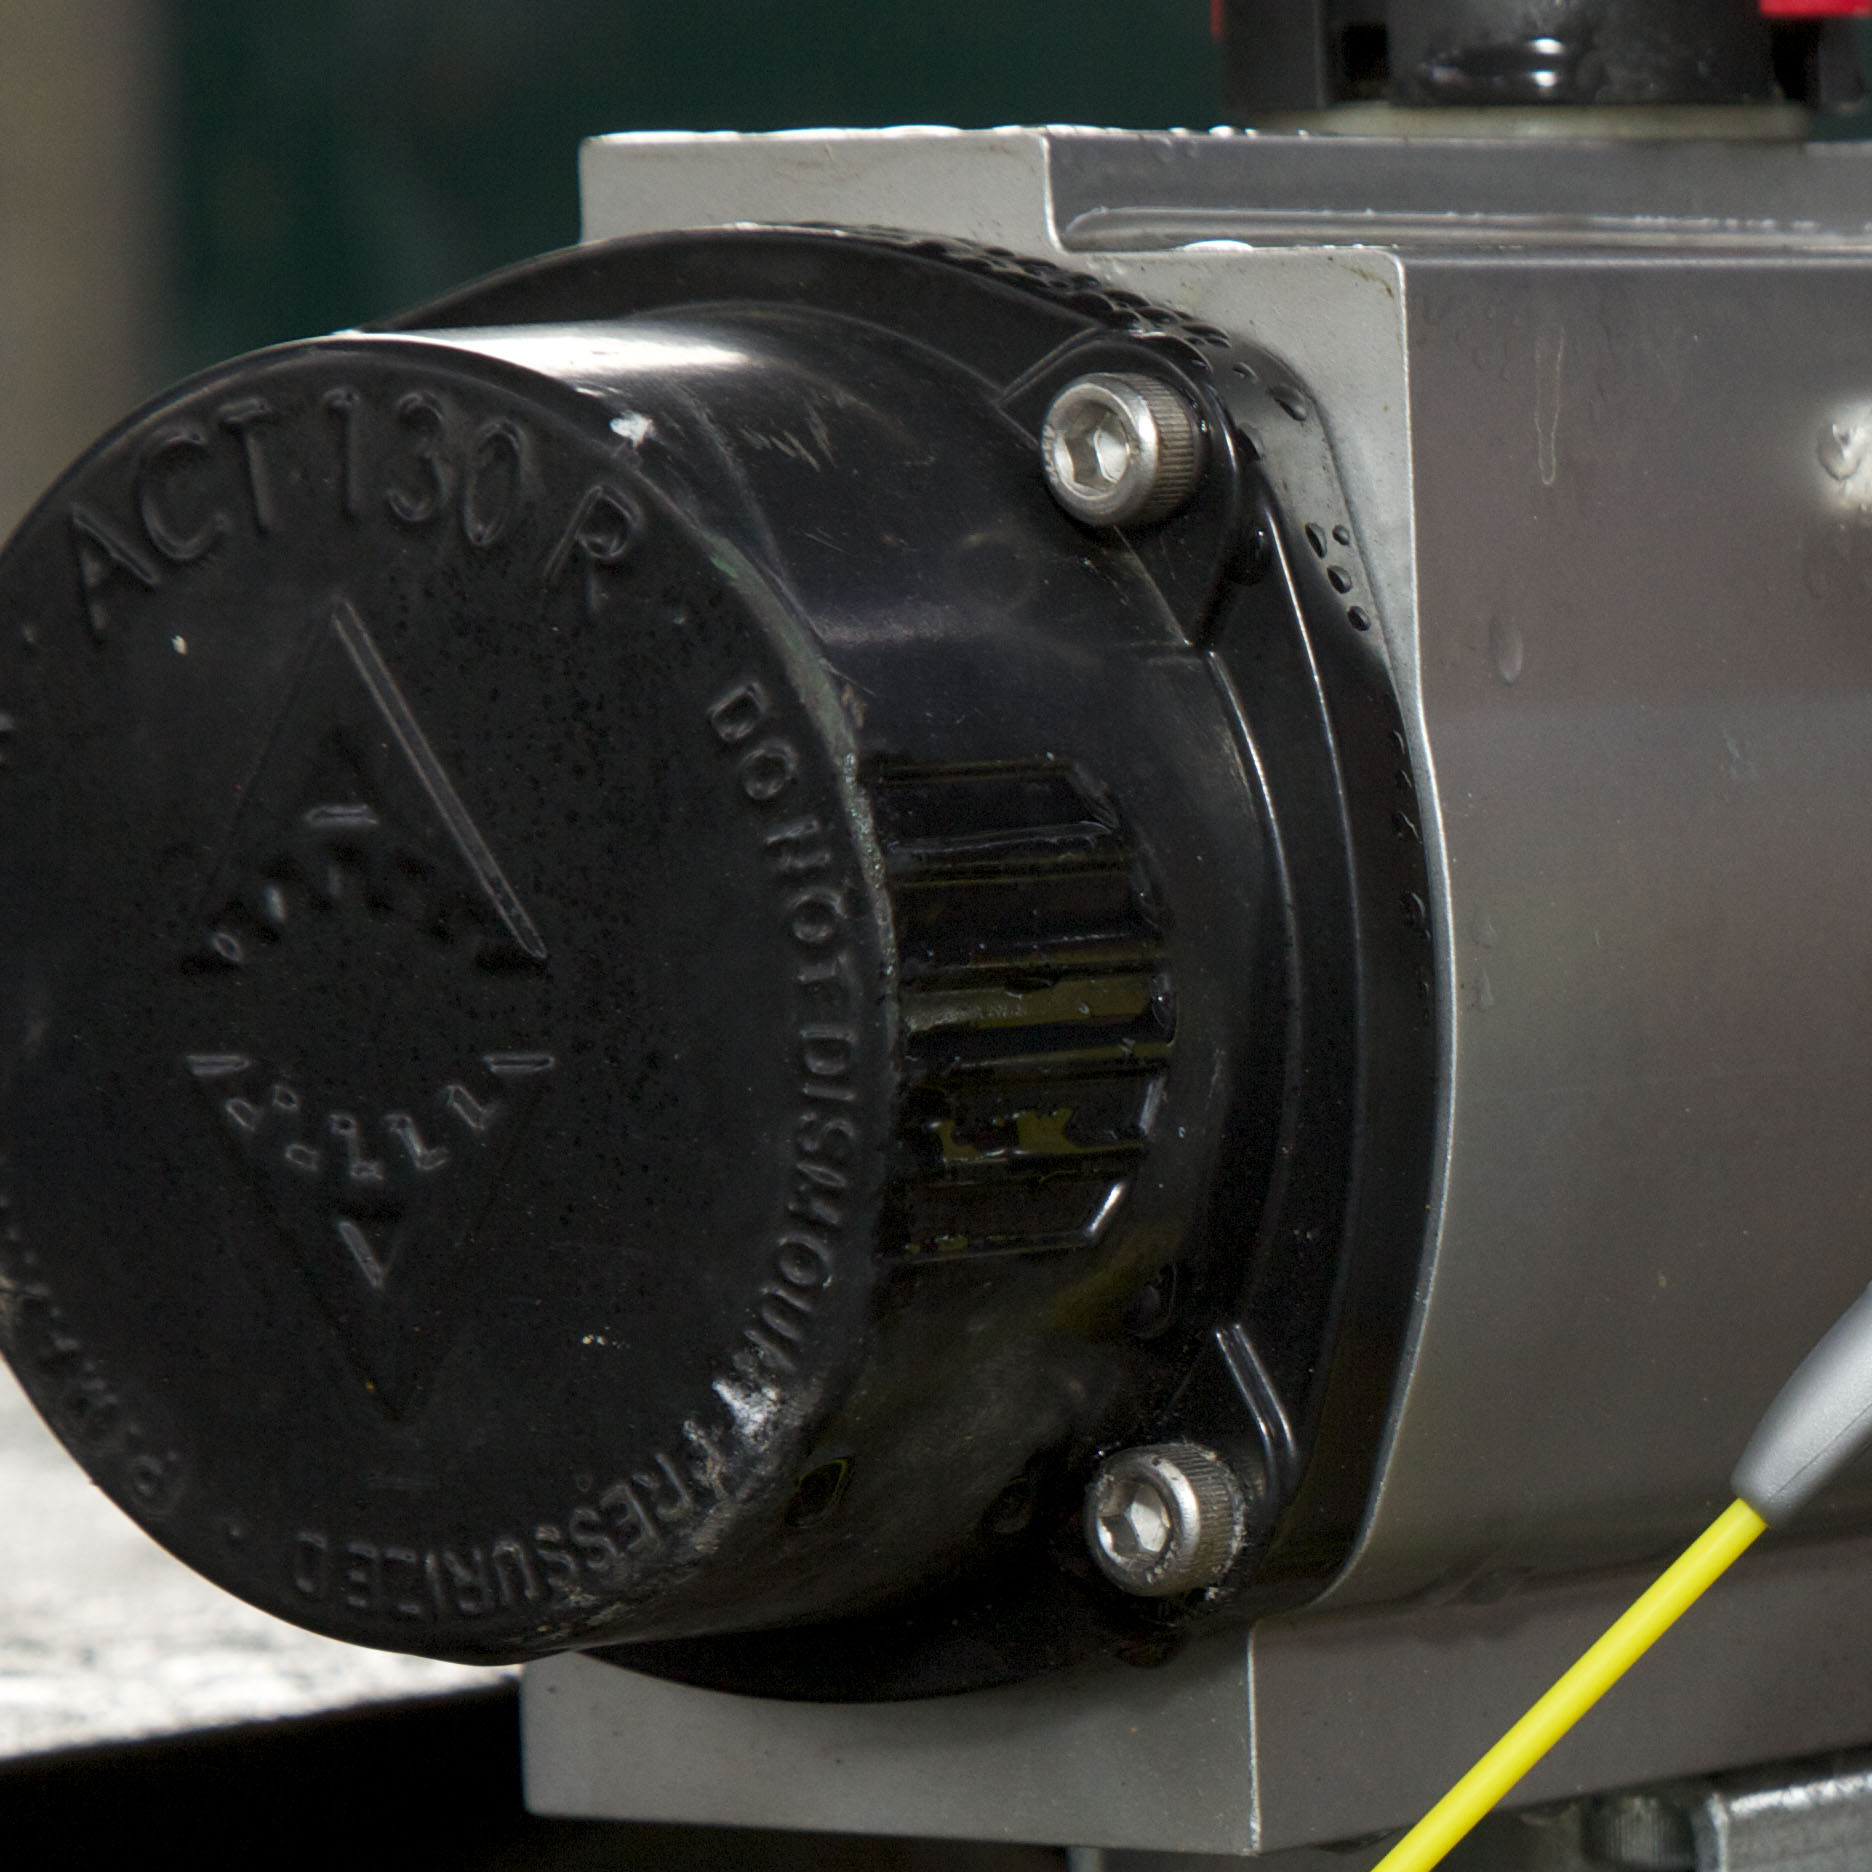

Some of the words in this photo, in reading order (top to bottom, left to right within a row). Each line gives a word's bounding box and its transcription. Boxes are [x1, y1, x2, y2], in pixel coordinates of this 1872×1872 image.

[68, 396, 279, 642] ACT
[320, 386, 528, 549] 130
[706, 678, 799, 802] DO
